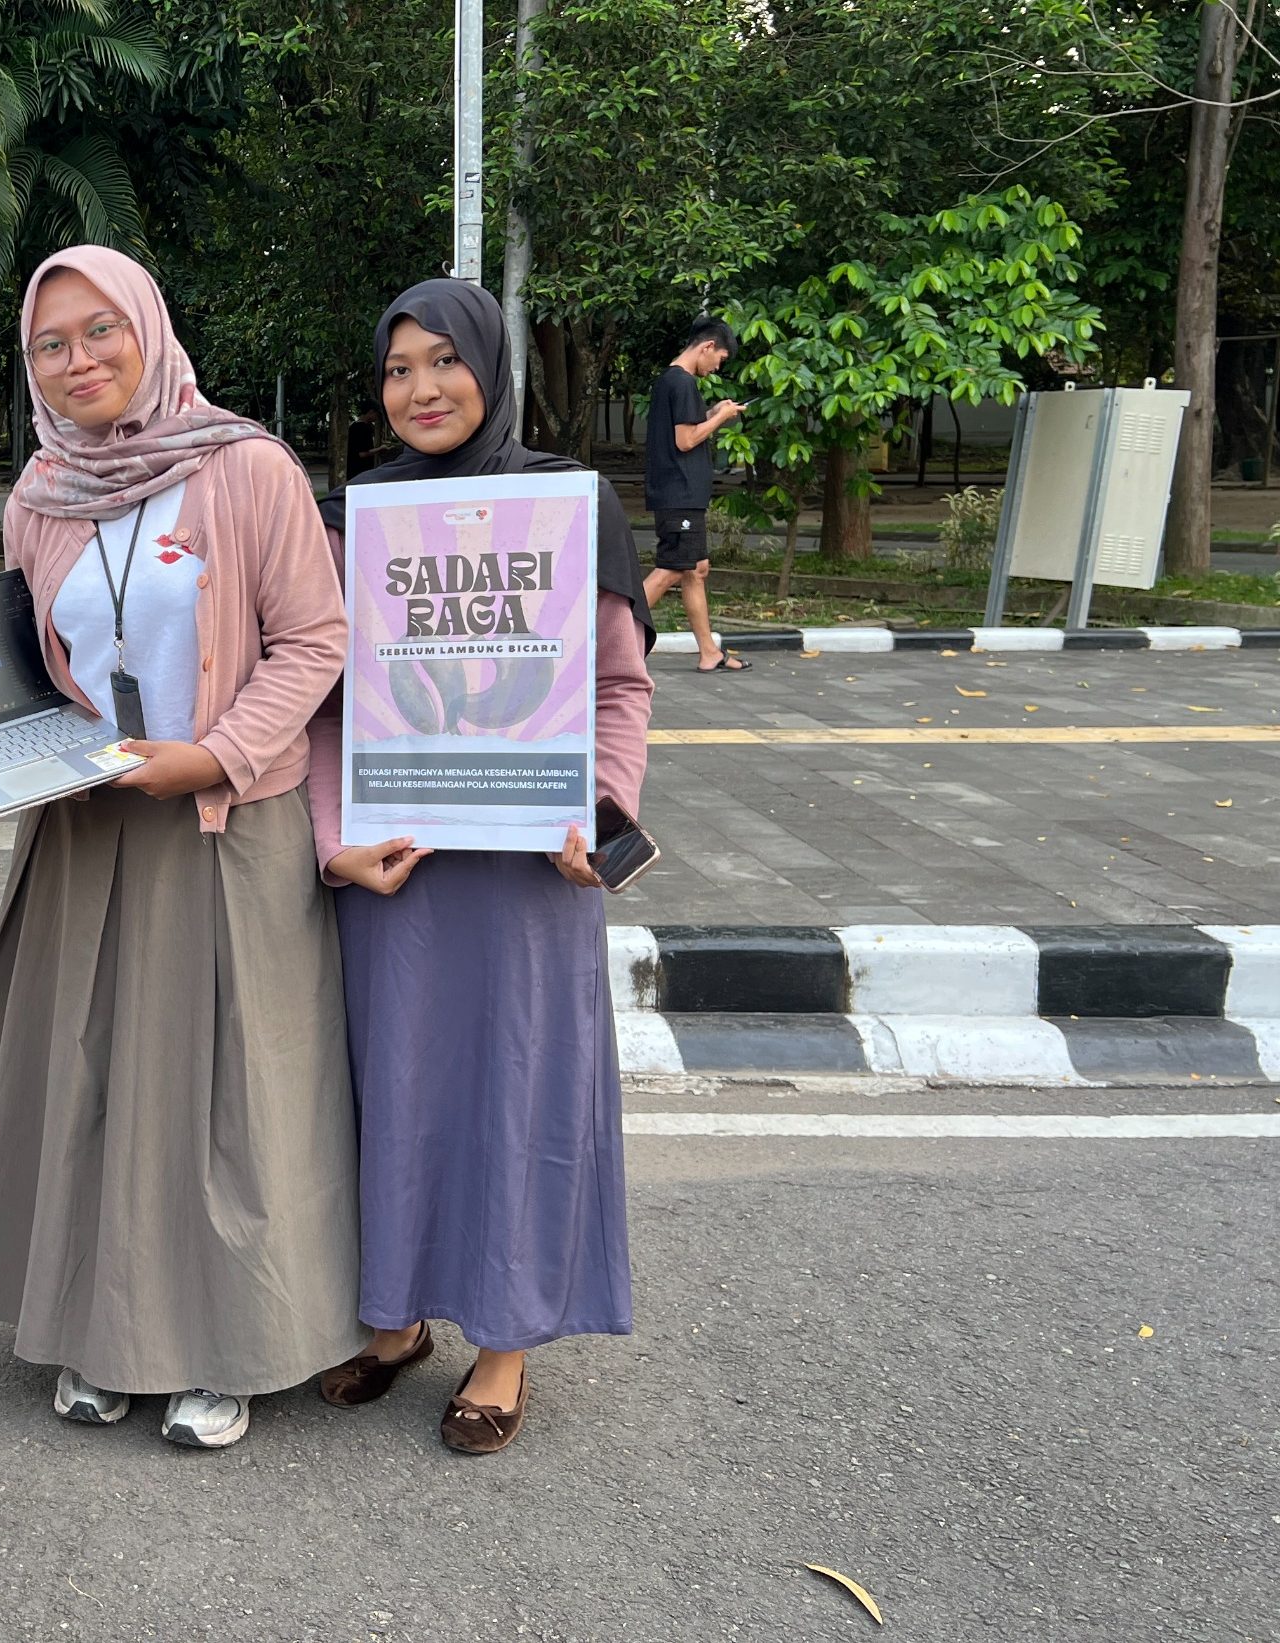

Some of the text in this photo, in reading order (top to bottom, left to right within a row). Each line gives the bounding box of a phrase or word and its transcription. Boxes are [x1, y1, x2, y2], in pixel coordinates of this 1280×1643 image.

[385, 551, 554, 596] SADARI
[406, 594, 531, 637] RAGA
[379, 644, 558, 656] SEBELUM LAMBUNG BICARA
[358, 768, 579, 777] EDUKASI PENTINGNYA MENJAGA KESEHATAN LAMBUNG
[369, 780, 401, 788] MELALUI
[467, 781, 488, 789] POLA
[490, 781, 535, 789] KONSUMSI
